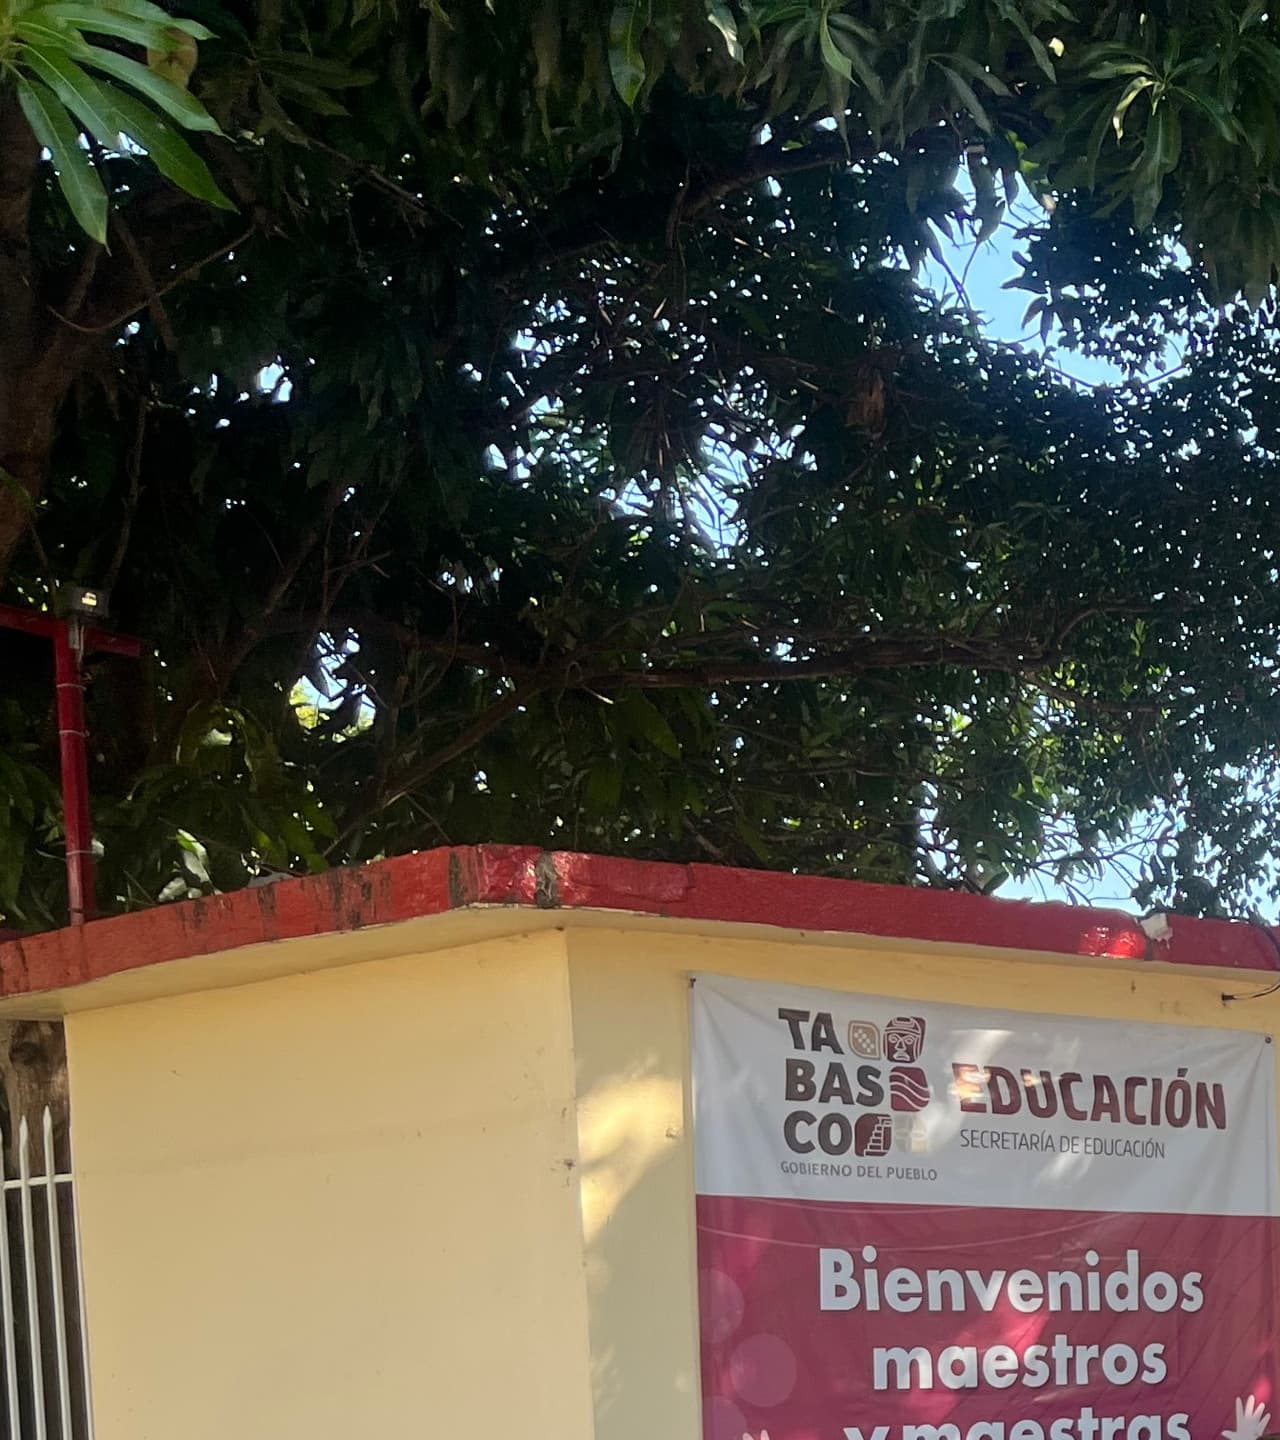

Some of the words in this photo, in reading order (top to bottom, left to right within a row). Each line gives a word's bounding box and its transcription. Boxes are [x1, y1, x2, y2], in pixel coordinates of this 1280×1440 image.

[778, 1008, 845, 1055] TA
[785, 1058, 885, 1107] BAS
[951, 1062, 1227, 1131] EDUCACIÓN
[783, 1110, 853, 1156] CO
[960, 1129, 1056, 1153] SECRETARÍA
[1059, 1135, 1080, 1154] DE
[1084, 1137, 1166, 1159] EDUCACIÓN
[780, 1160, 853, 1177] GOBIERNO
[856, 1165, 883, 1179] DEL
[886, 1166, 938, 1181] PUEBLO
[818, 1244, 1204, 1313] Bienvenidos
[872, 1334, 1168, 1391] maestros
